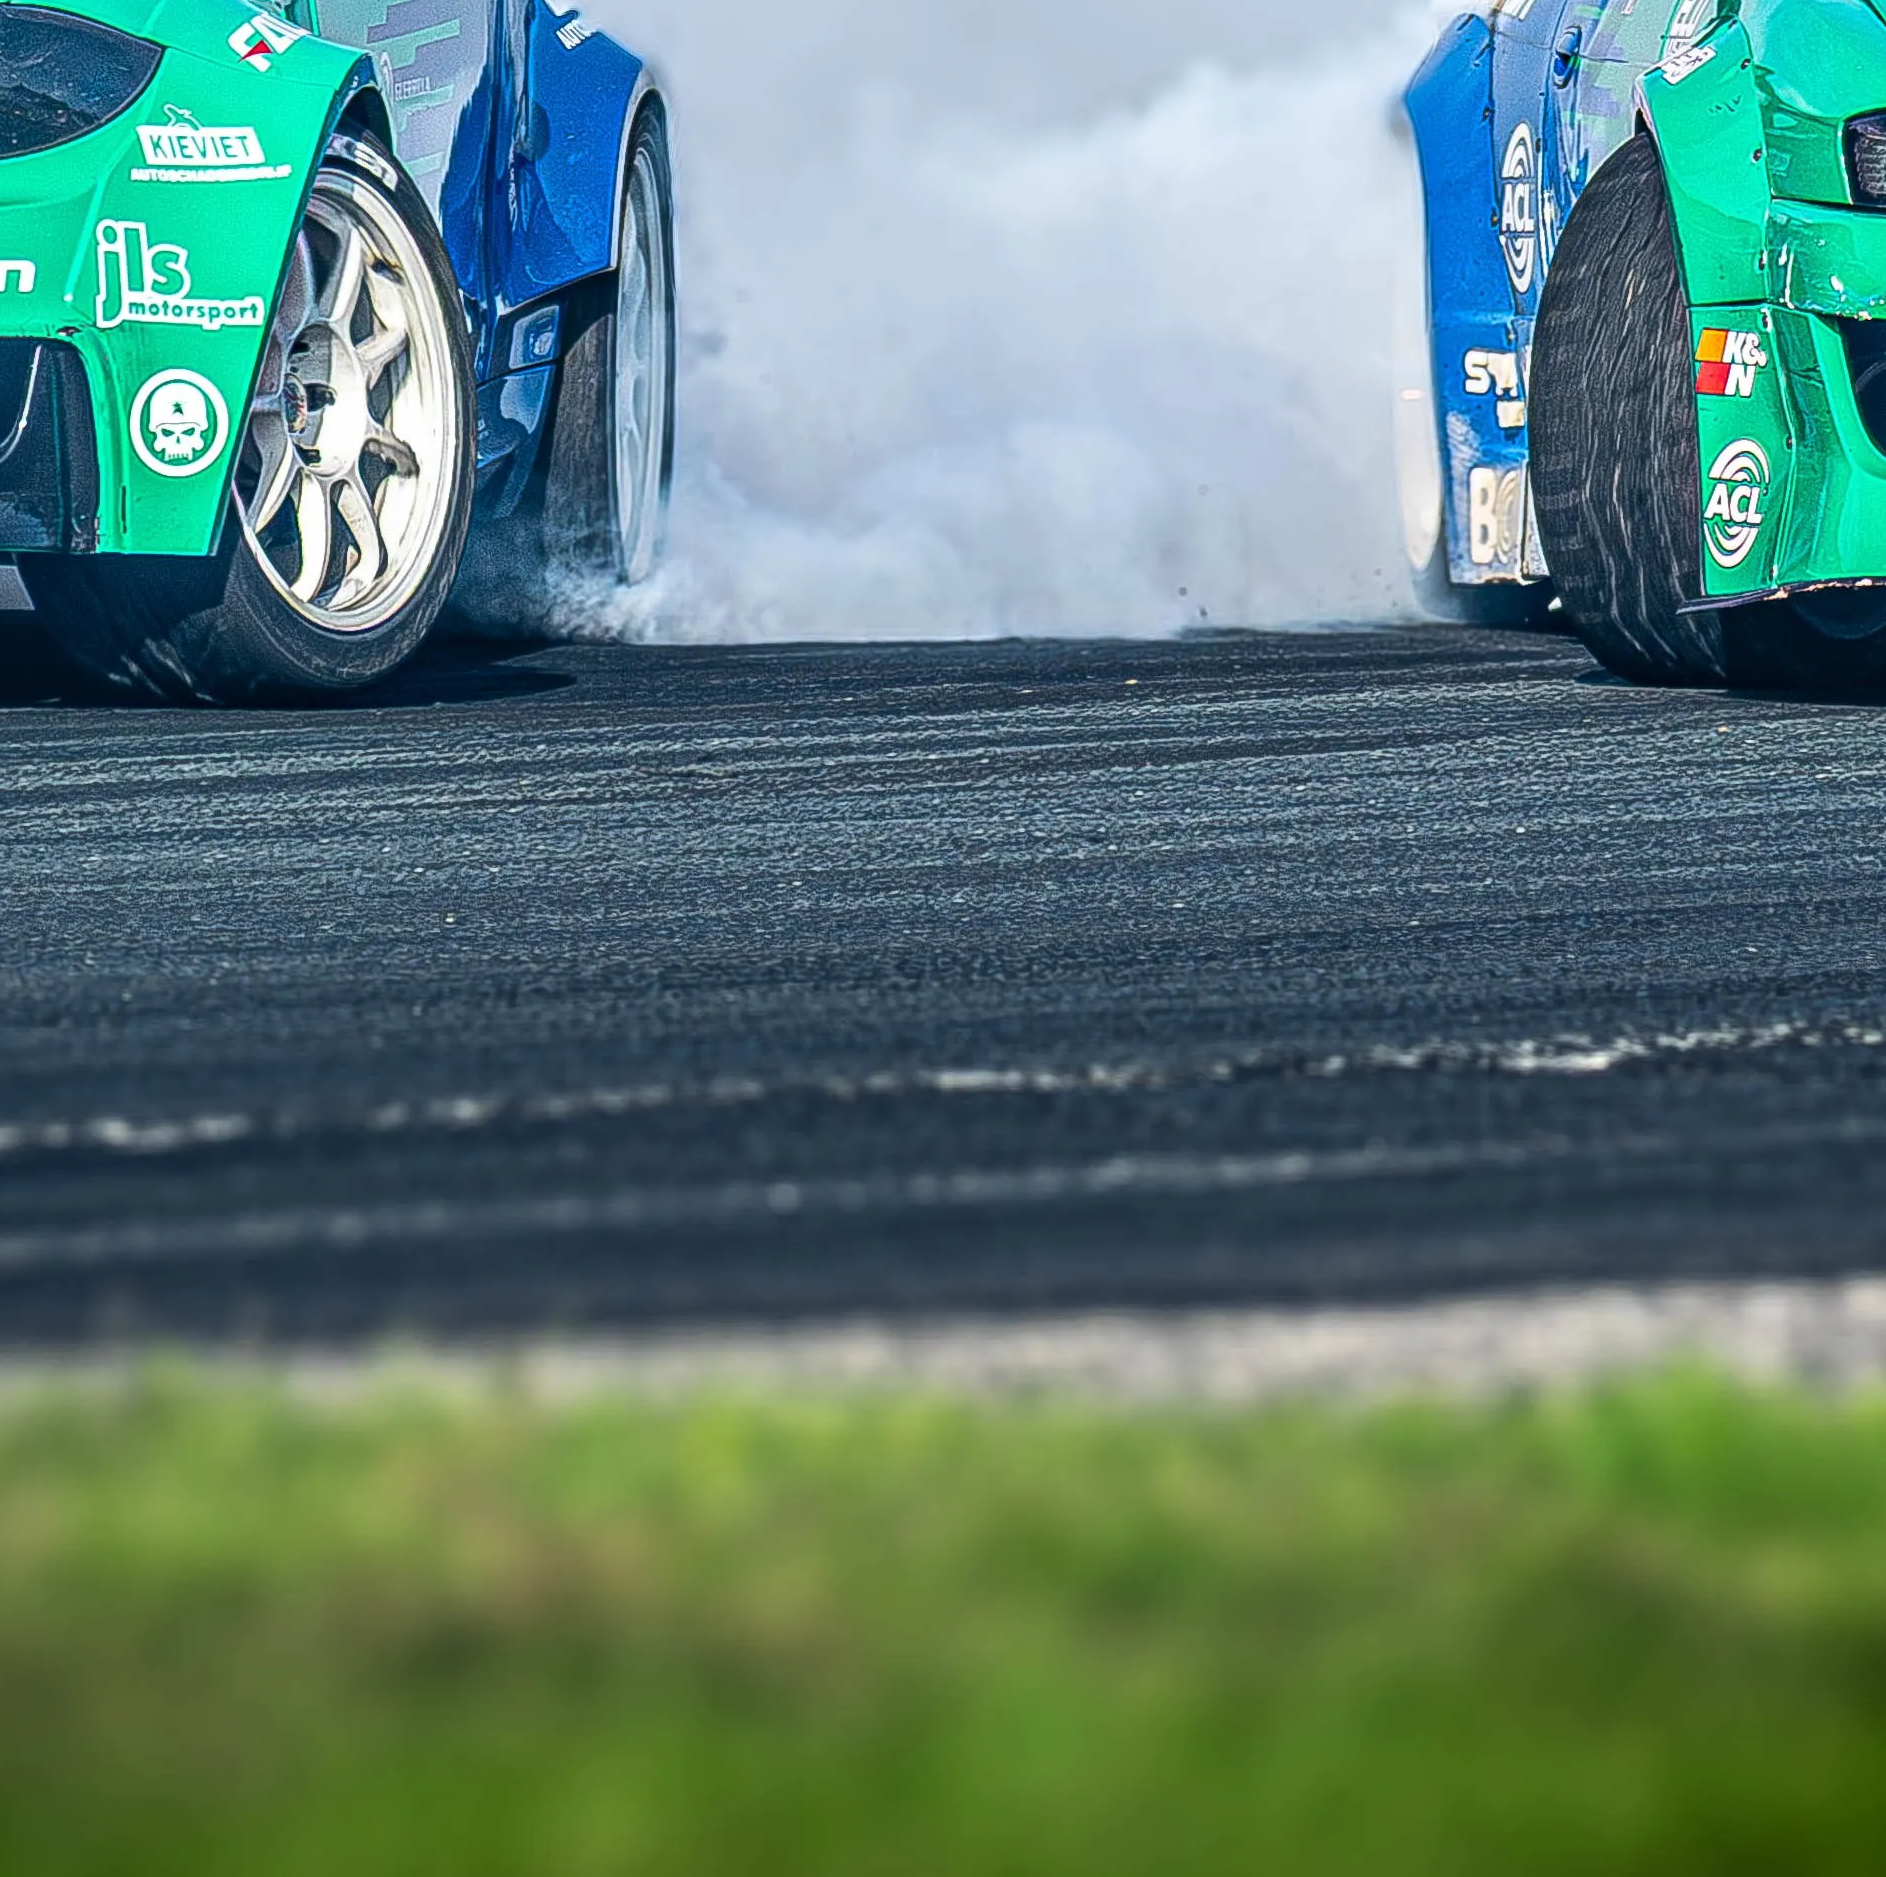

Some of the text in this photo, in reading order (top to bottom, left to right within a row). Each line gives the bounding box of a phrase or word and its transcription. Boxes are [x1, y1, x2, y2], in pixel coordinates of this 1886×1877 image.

[148, 133, 251, 160] KIEVIET
[1501, 182, 1535, 233] ACL
[127, 299, 259, 324] motorsport
[1703, 482, 1763, 524] ACL
